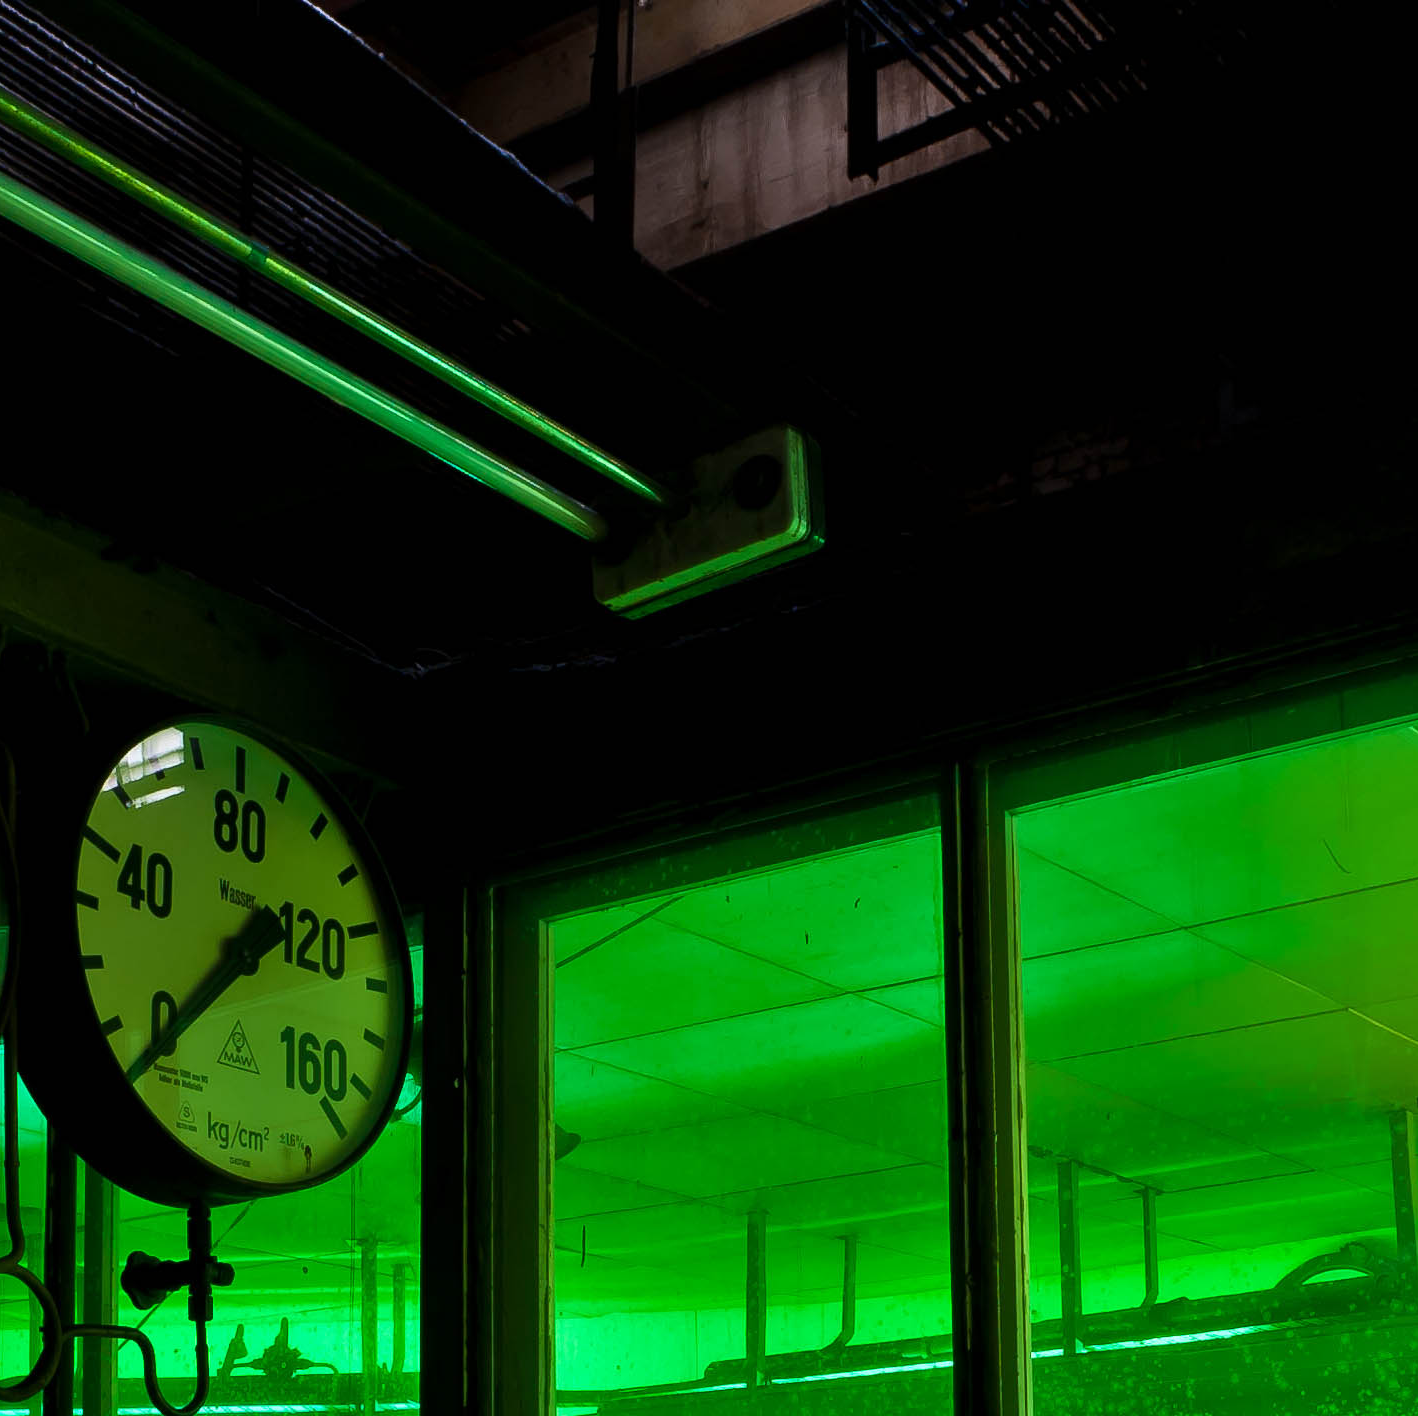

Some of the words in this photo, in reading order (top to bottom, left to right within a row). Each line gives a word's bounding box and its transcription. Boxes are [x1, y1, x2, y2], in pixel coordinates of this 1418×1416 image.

[213, 789, 266, 863] 80
[117, 844, 173, 919] 40
[219, 878, 257, 911] Wasser
[280, 901, 345, 981] 120
[150, 990, 180, 1057] 0
[280, 1025, 347, 1101] 160
